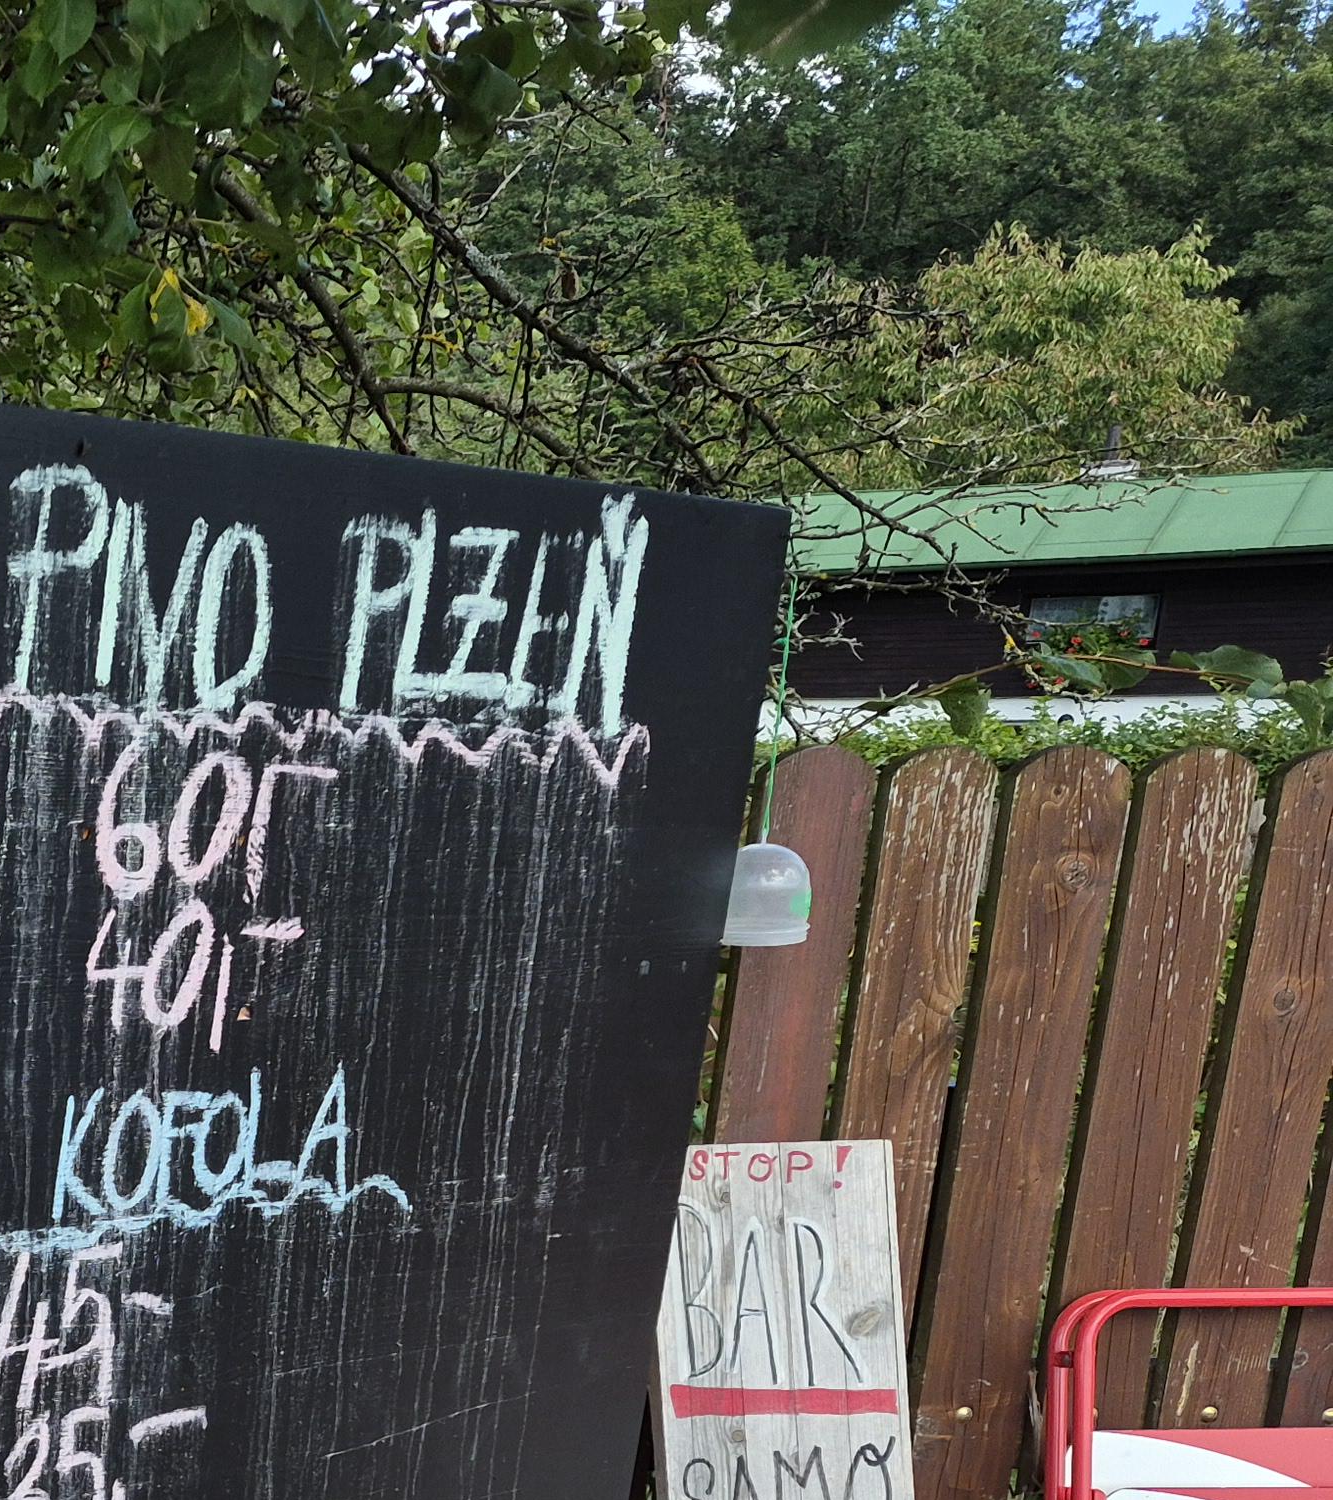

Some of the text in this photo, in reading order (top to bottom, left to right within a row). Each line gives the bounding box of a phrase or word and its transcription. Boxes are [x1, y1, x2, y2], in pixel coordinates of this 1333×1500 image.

[8, 462, 272, 709] PIVO
[51, 1062, 351, 1222] KOFOLA
[676, 1202, 865, 1388] BAR
